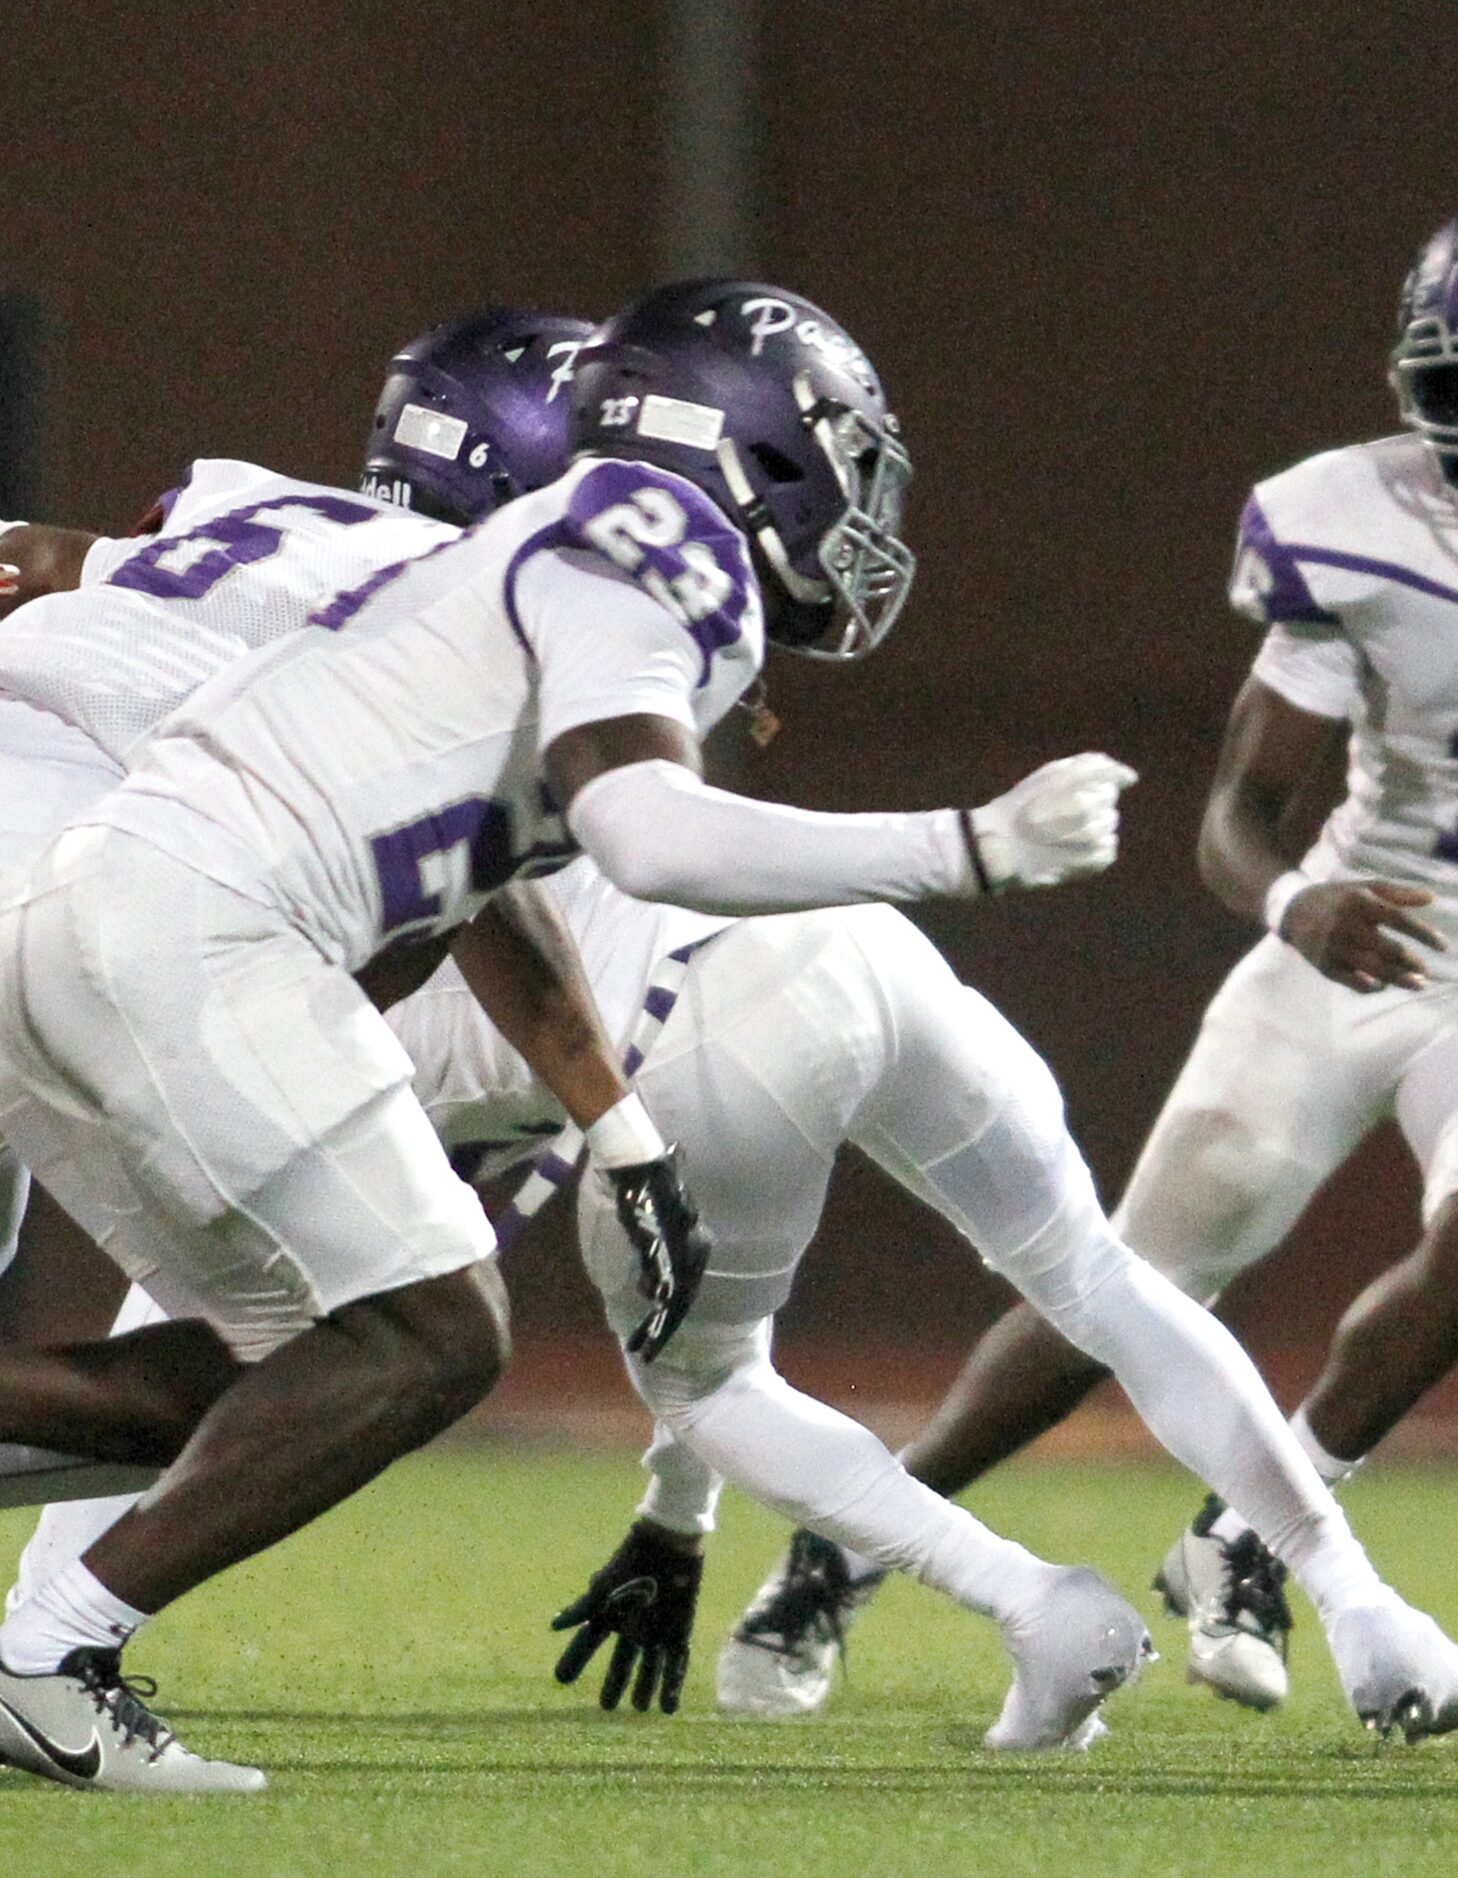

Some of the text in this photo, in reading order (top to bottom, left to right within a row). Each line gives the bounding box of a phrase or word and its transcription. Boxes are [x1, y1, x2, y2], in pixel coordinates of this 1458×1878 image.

[600, 398, 632, 426] 23
[468, 443, 490, 469] 6
[361, 473, 412, 509] dell
[107, 494, 378, 601] 6
[586, 486, 732, 625] 23
